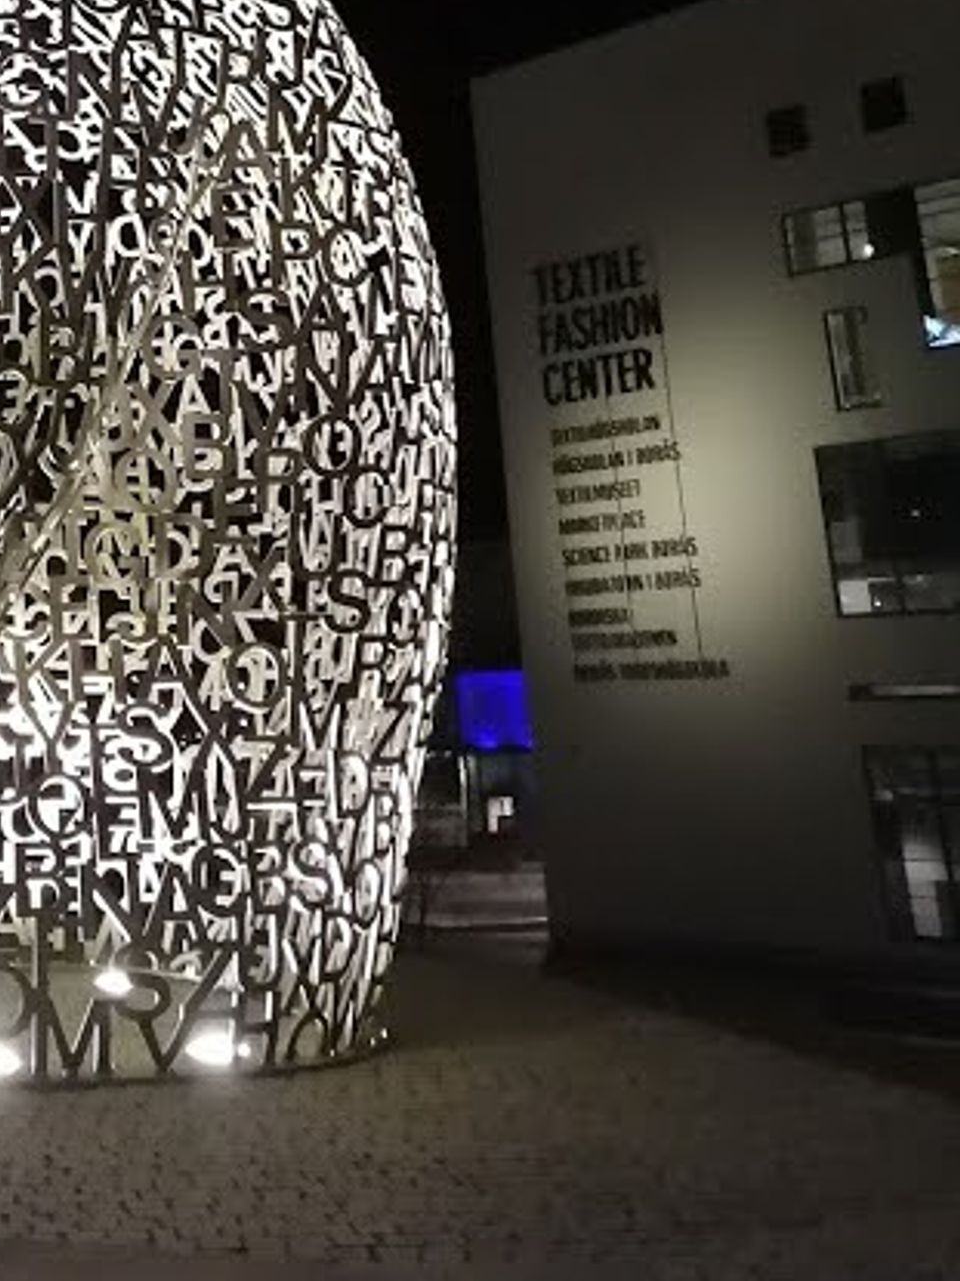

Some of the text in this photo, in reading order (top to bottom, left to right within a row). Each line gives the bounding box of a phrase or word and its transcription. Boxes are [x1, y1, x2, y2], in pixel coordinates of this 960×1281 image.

[530, 245, 645, 304] TEXTILE
[537, 290, 663, 356] FASHION
[543, 348, 656, 406] CENTER
